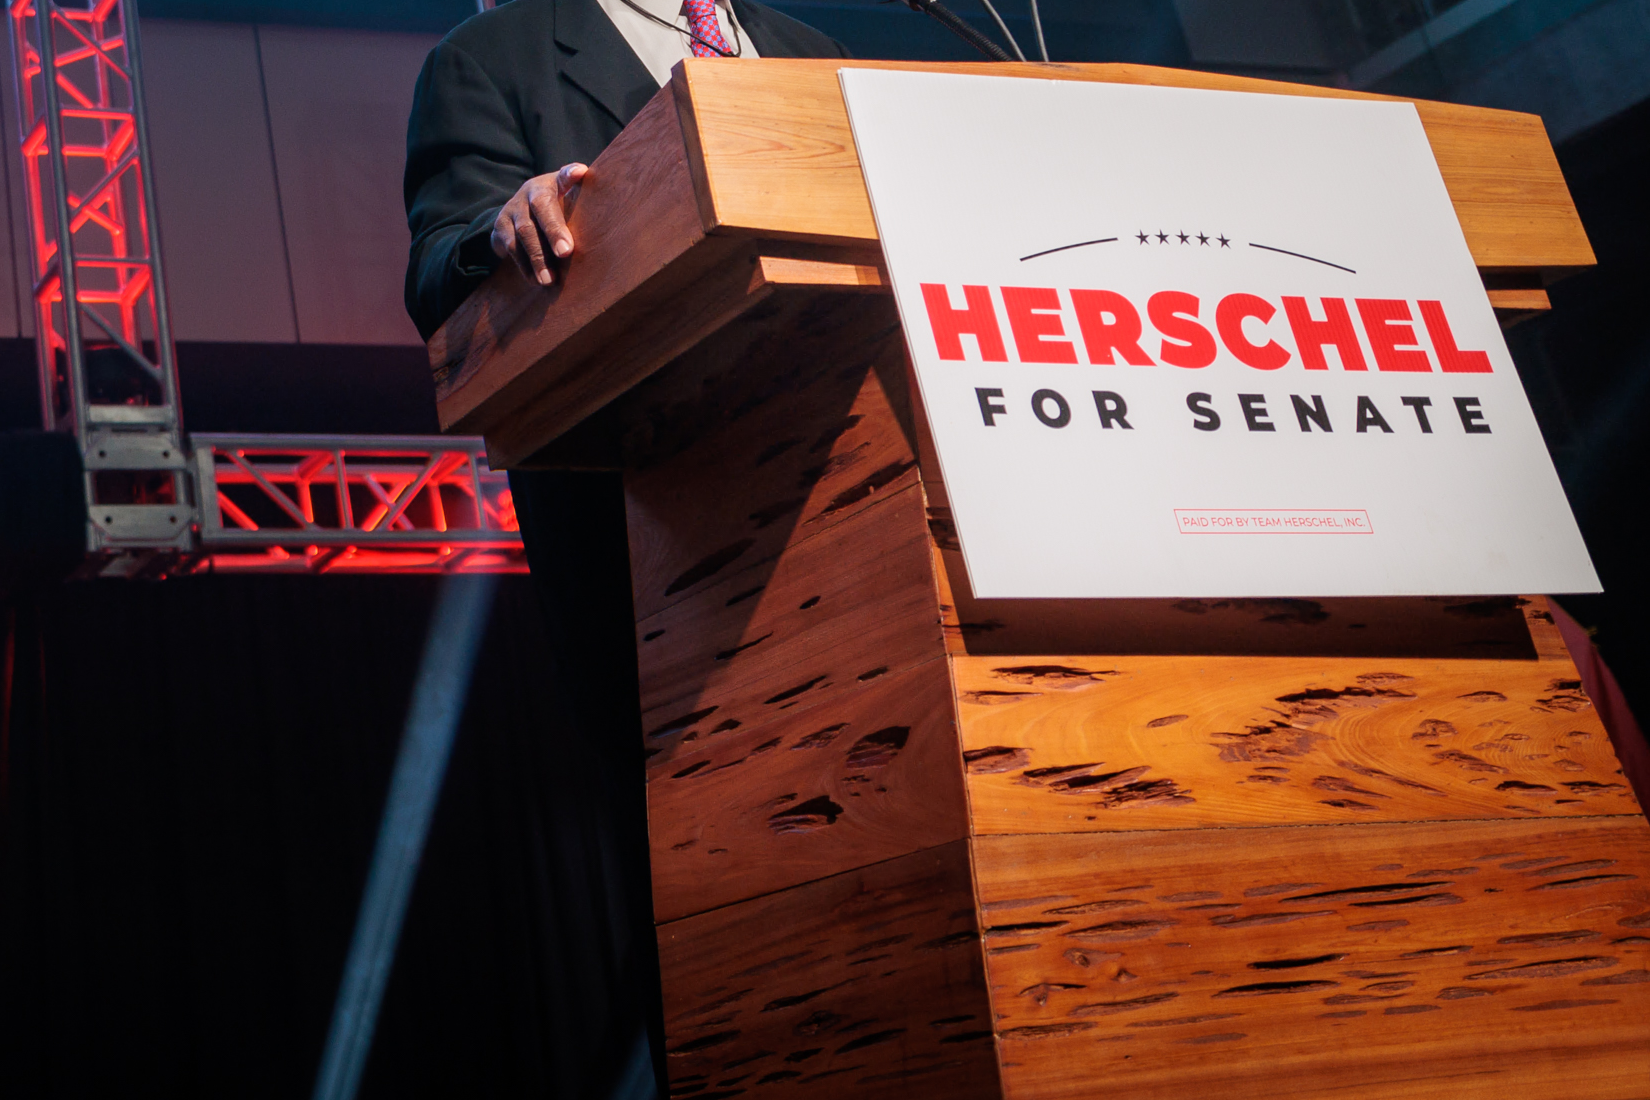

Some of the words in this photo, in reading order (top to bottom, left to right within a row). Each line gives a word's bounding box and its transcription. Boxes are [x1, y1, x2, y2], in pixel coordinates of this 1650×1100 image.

[919, 283, 1493, 373] HERSCHEL
[974, 386, 1135, 430] FOR
[1186, 392, 1493, 434] SENATE
[1183, 517, 1208, 527] PAID
[1211, 517, 1234, 527] FOR
[1236, 517, 1249, 527] BY
[1251, 517, 1281, 527] TEAM
[1284, 517, 1343, 529] HERSCHEL,
[1344, 518, 1366, 527] INC.
